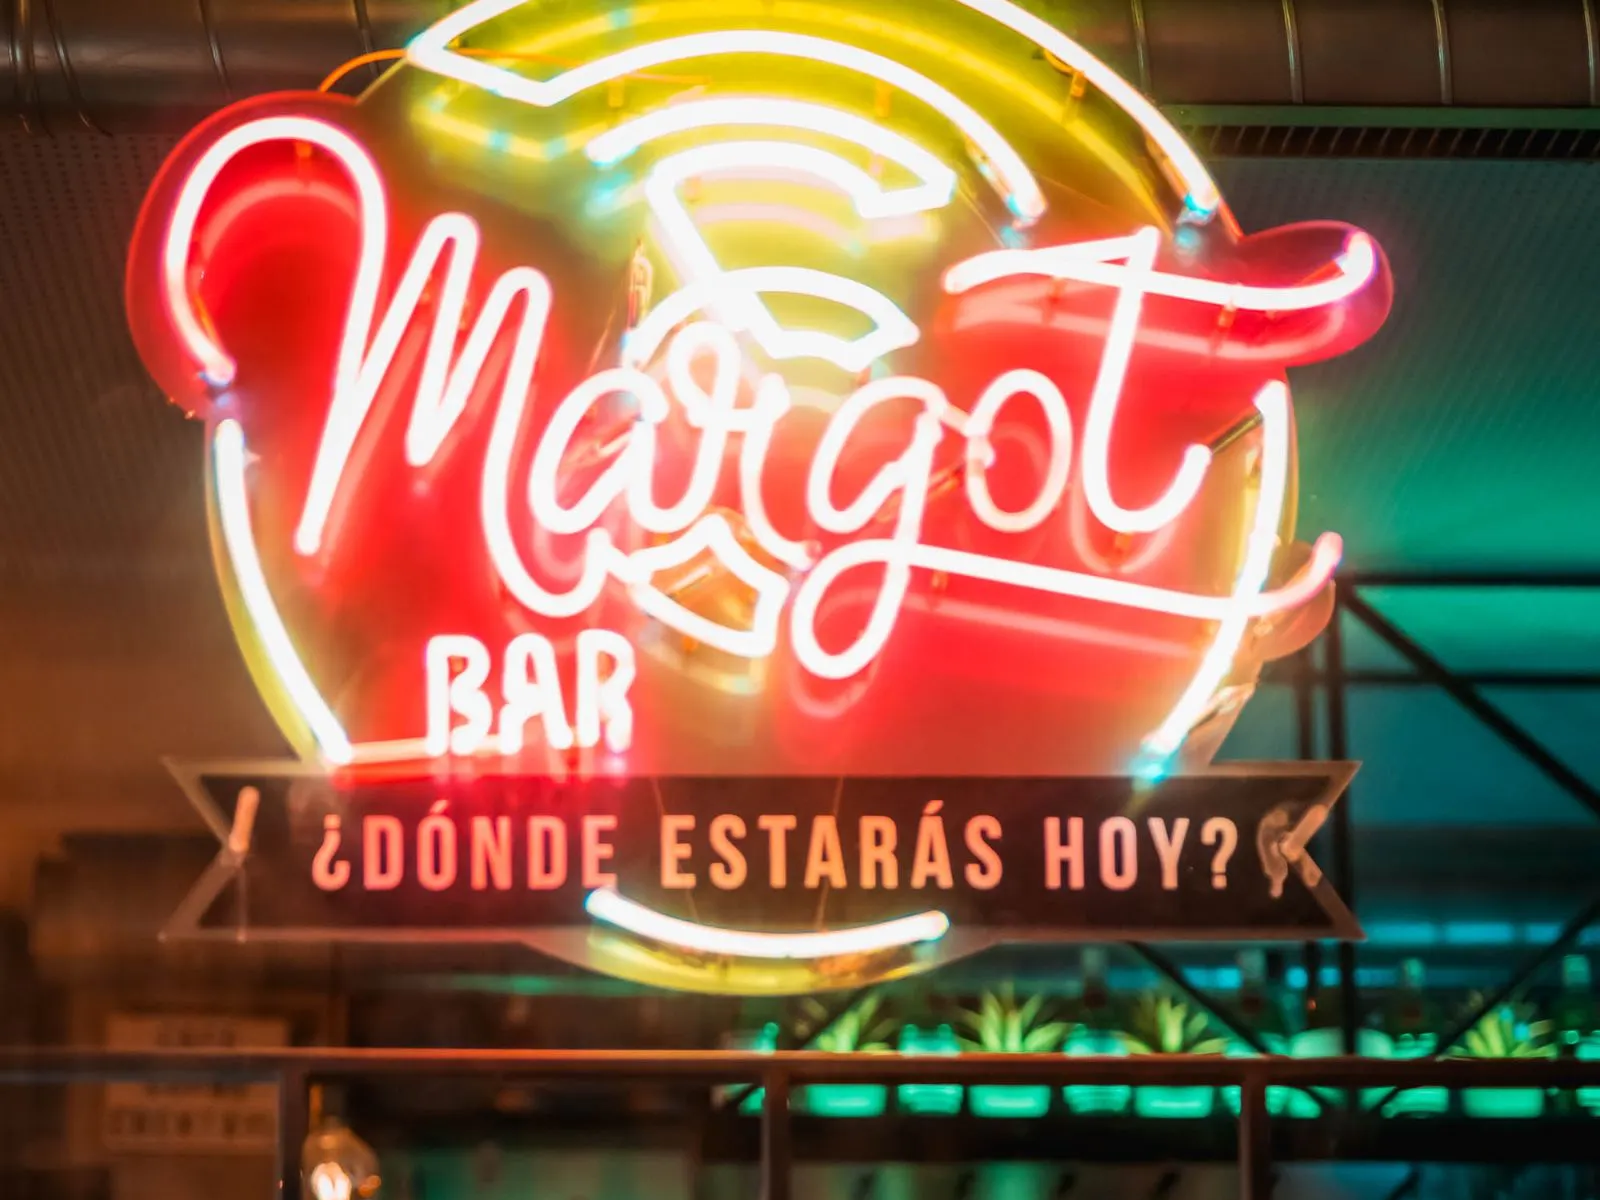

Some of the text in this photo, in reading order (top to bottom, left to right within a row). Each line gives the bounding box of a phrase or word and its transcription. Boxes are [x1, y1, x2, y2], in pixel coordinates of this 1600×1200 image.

[163, 115, 1376, 680] Margot
[426, 628, 636, 756] BAR
[311, 799, 1238, 891] ¿DÓNDE ESTARÁS HOY?
